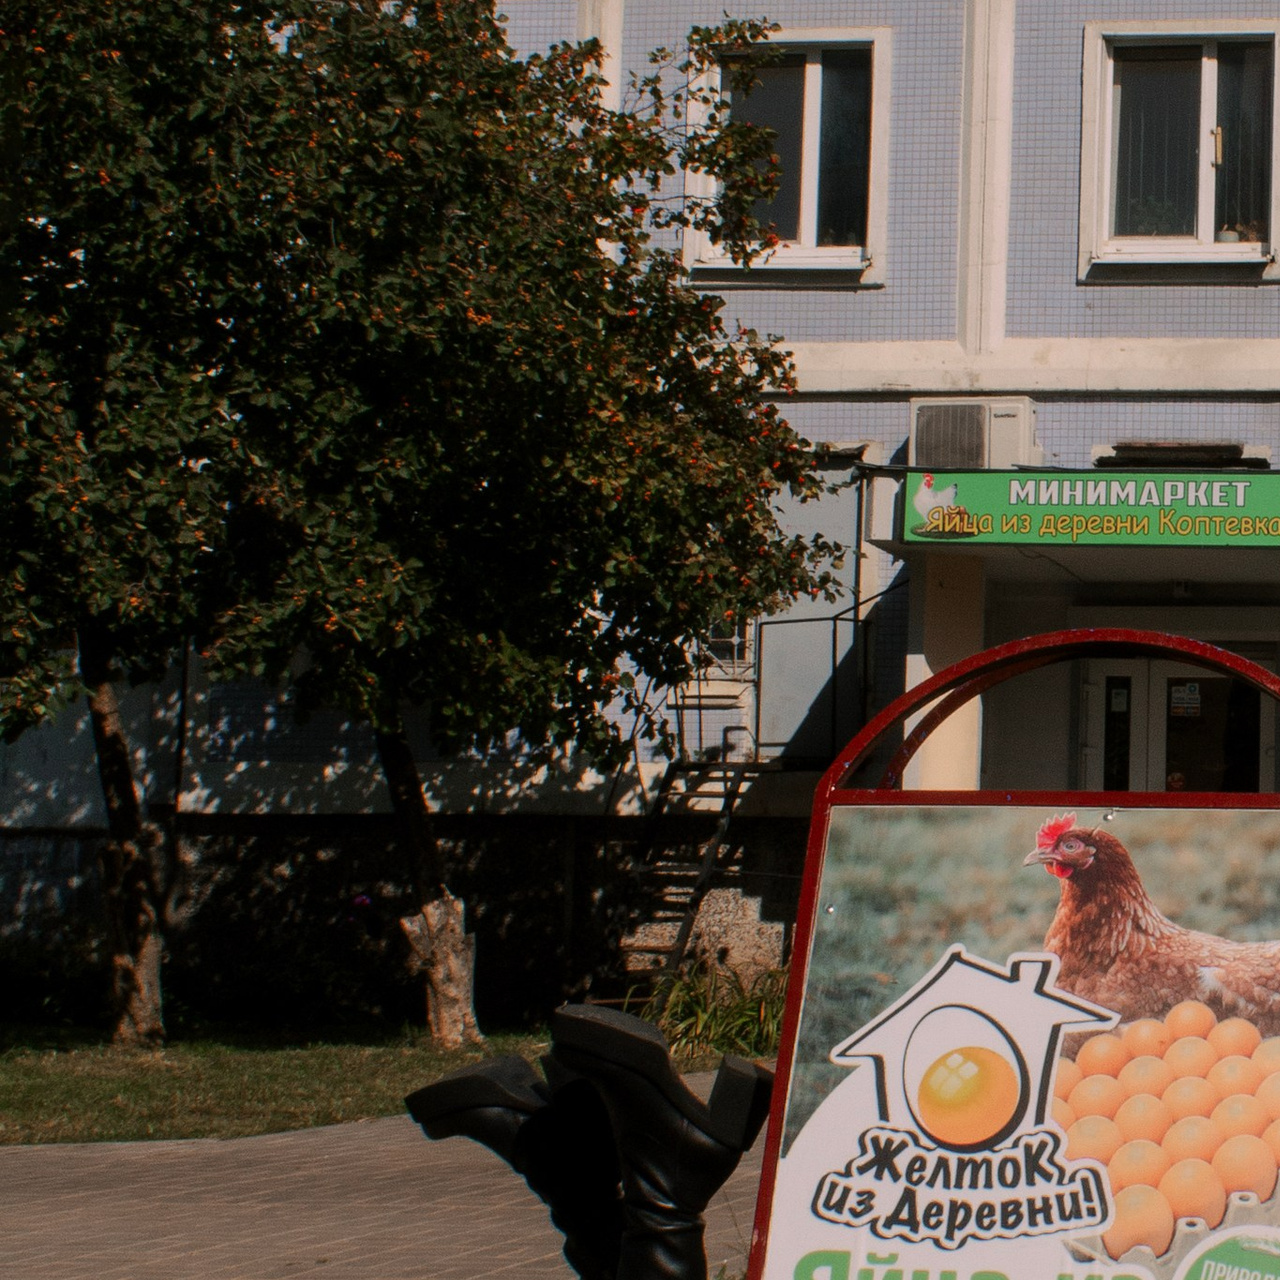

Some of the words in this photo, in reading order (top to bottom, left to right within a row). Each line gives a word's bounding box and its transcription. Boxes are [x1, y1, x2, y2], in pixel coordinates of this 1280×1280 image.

[1008, 479, 1251, 507] МИНИМАРКЕТ
[926, 506, 994, 536] Яйца
[1001, 514, 1031, 532] из
[1038, 513, 1149, 542] деревни
[821, 1180, 876, 1218] из
[882, 1176, 1098, 1241] Деревни!
